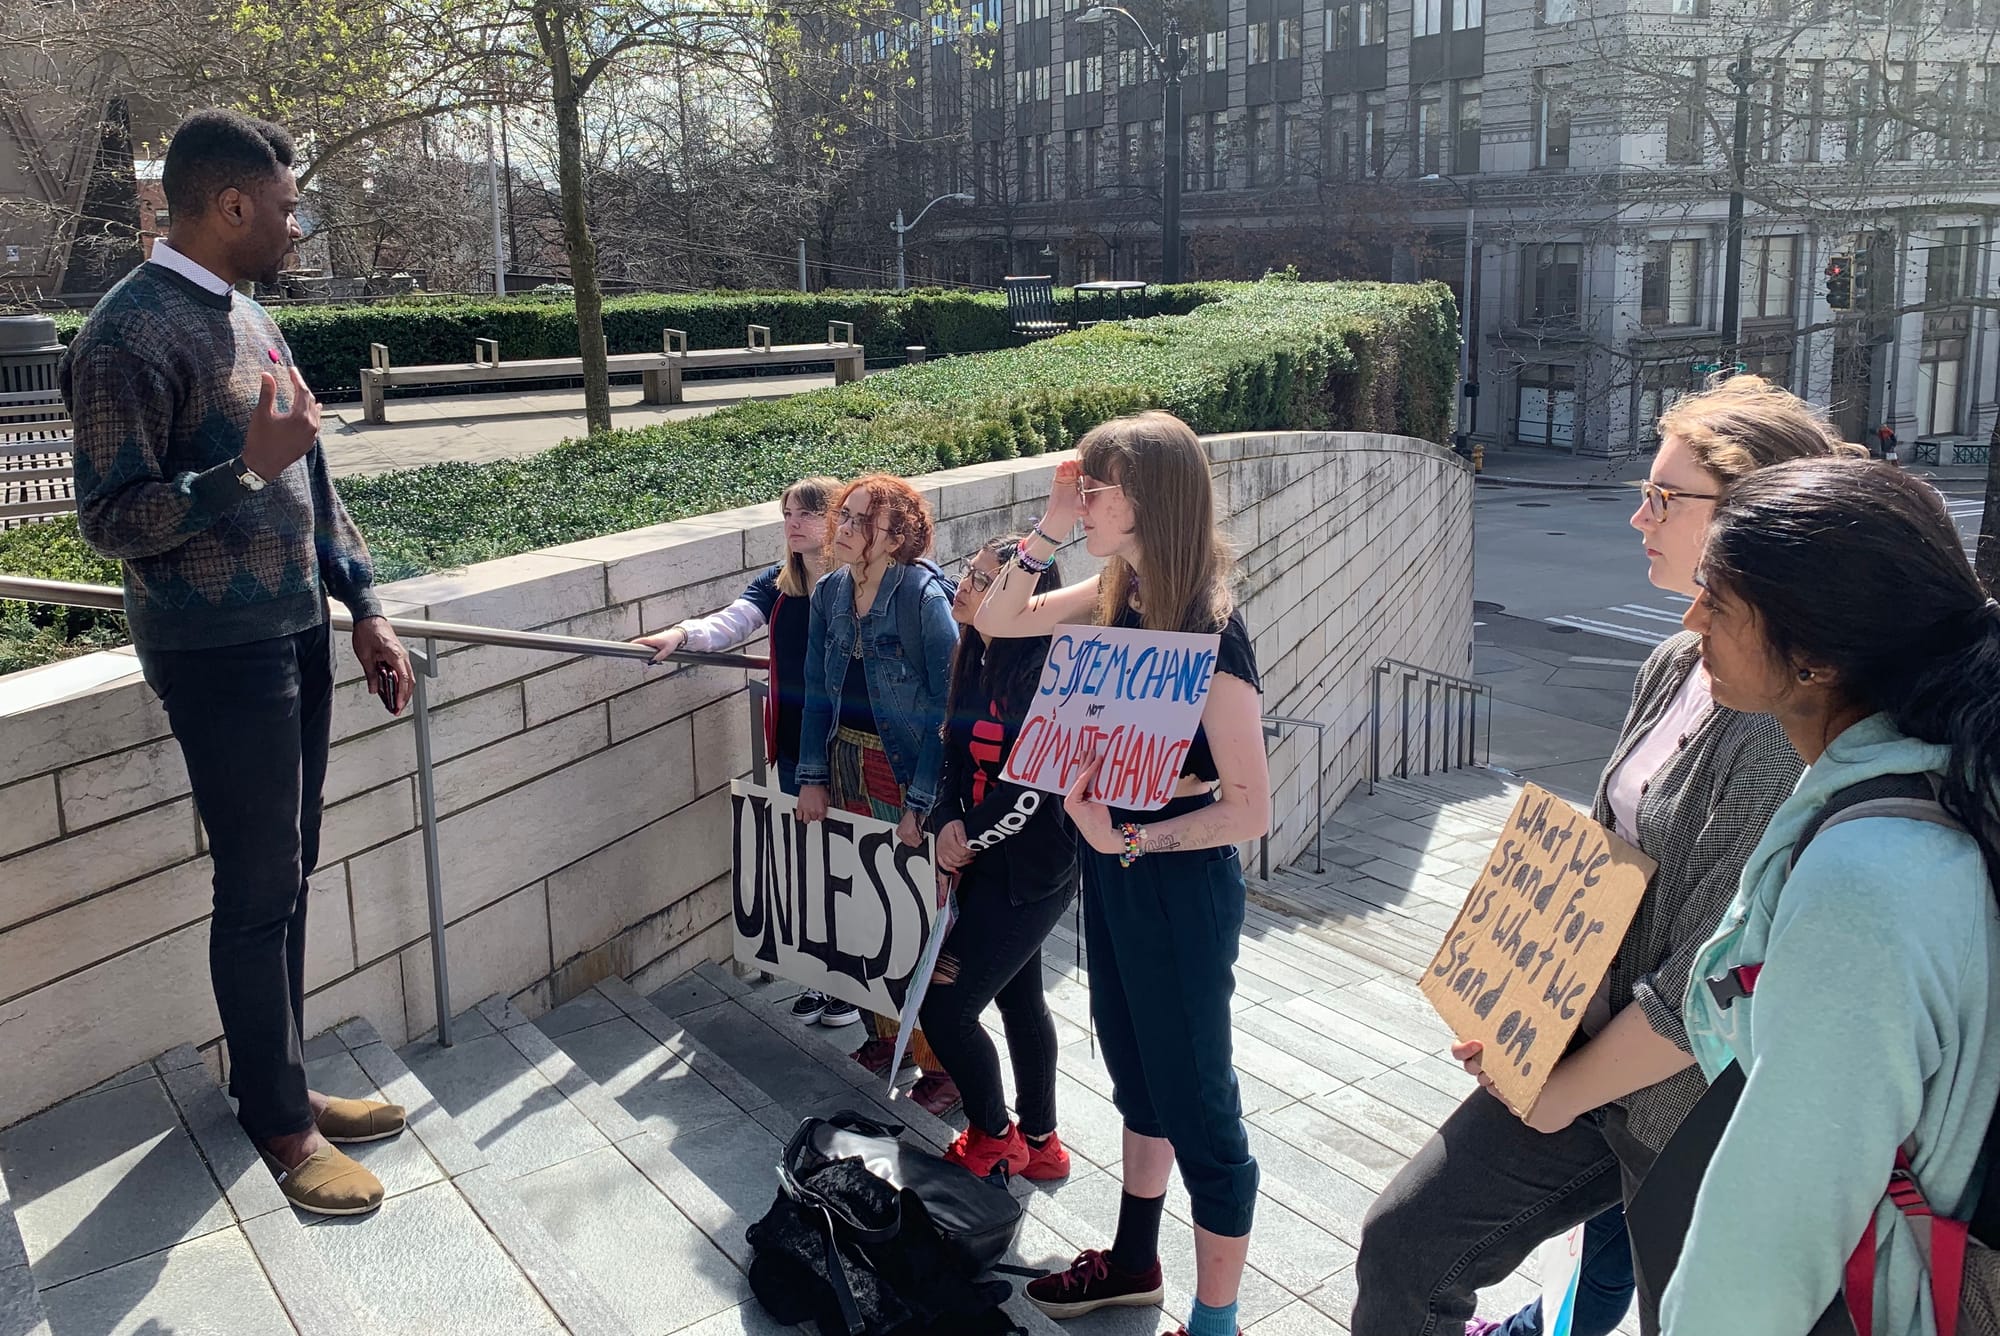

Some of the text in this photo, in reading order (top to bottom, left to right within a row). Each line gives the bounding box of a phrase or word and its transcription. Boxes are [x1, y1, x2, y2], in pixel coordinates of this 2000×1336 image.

[1086, 703, 1105, 718] NOT
[1094, 724, 1190, 807] CHANGE
[966, 791, 1040, 851] adida
[1515, 794, 1610, 887] What We
[731, 794, 931, 1016] UNLESS
[1491, 839, 1568, 915] Stand
[1434, 931, 1537, 1076] Stand on.
